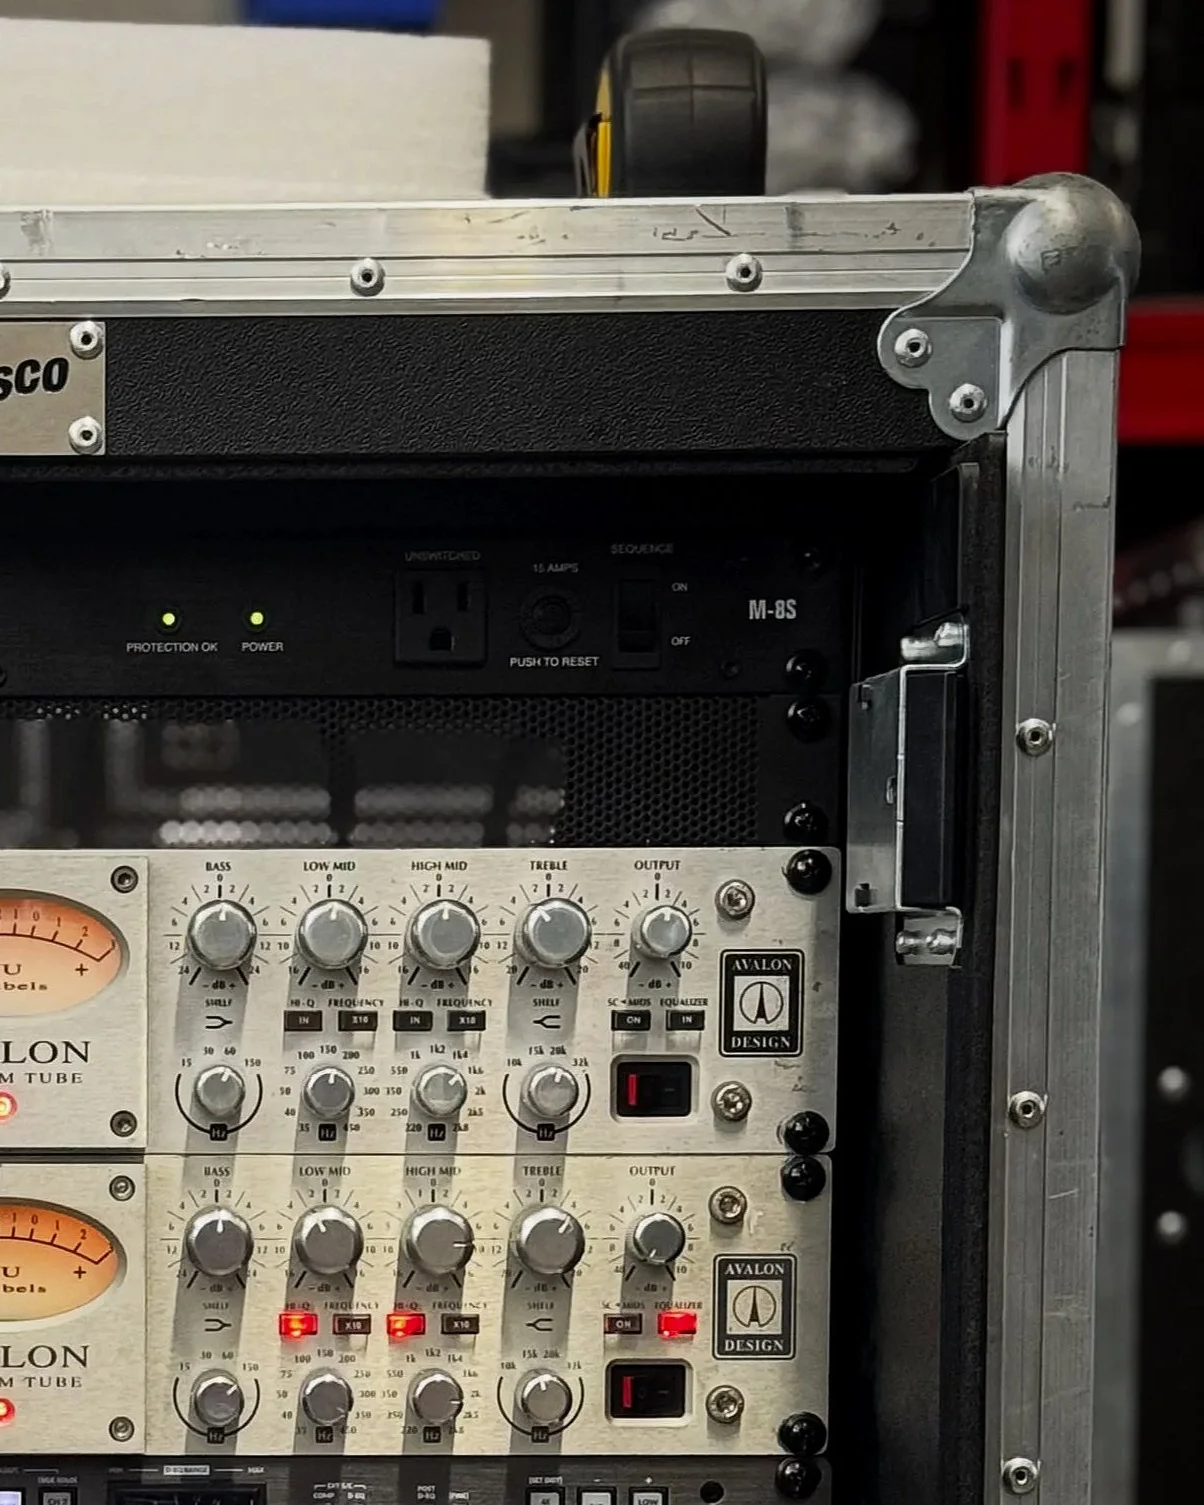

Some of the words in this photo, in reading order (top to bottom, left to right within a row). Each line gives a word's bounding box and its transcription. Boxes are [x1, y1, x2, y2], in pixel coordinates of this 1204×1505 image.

[611, 544, 674, 555] SEQUENCE
[405, 551, 481, 561] UNSWITCHED
[672, 583, 688, 591] ON
[749, 599, 797, 620] M-8S
[671, 636, 690, 646] OFF
[126, 642, 198, 652] PROTECTION
[201, 642, 218, 652] OK
[241, 642, 284, 652] POWER
[510, 657, 541, 667] PUSH
[543, 657, 558, 667] TO
[562, 657, 600, 667] RESET
[206, 862, 231, 871] BASS
[304, 862, 329, 871] LOW
[333, 861, 355, 871] MID
[412, 862, 441, 871] HIGH
[446, 861, 467, 871] MID
[530, 861, 567, 871] TREBLE
[634, 861, 681, 870] OUTPUT
[732, 959, 792, 970] AVALON
[732, 1036, 790, 1049] DESIGN
[24, 1072, 83, 1084] TUBE
[299, 1166, 326, 1176] LOW
[329, 1166, 351, 1176] MID
[406, 1166, 435, 1176] HIGH
[439, 1166, 461, 1176] MID
[523, 1166, 561, 1176] TREBLE
[629, 1166, 675, 1176] OUTPUT
[725, 1263, 785, 1275] AVALON
[725, 1340, 784, 1352] DESIGN
[24, 1377, 82, 1388] TUBE
